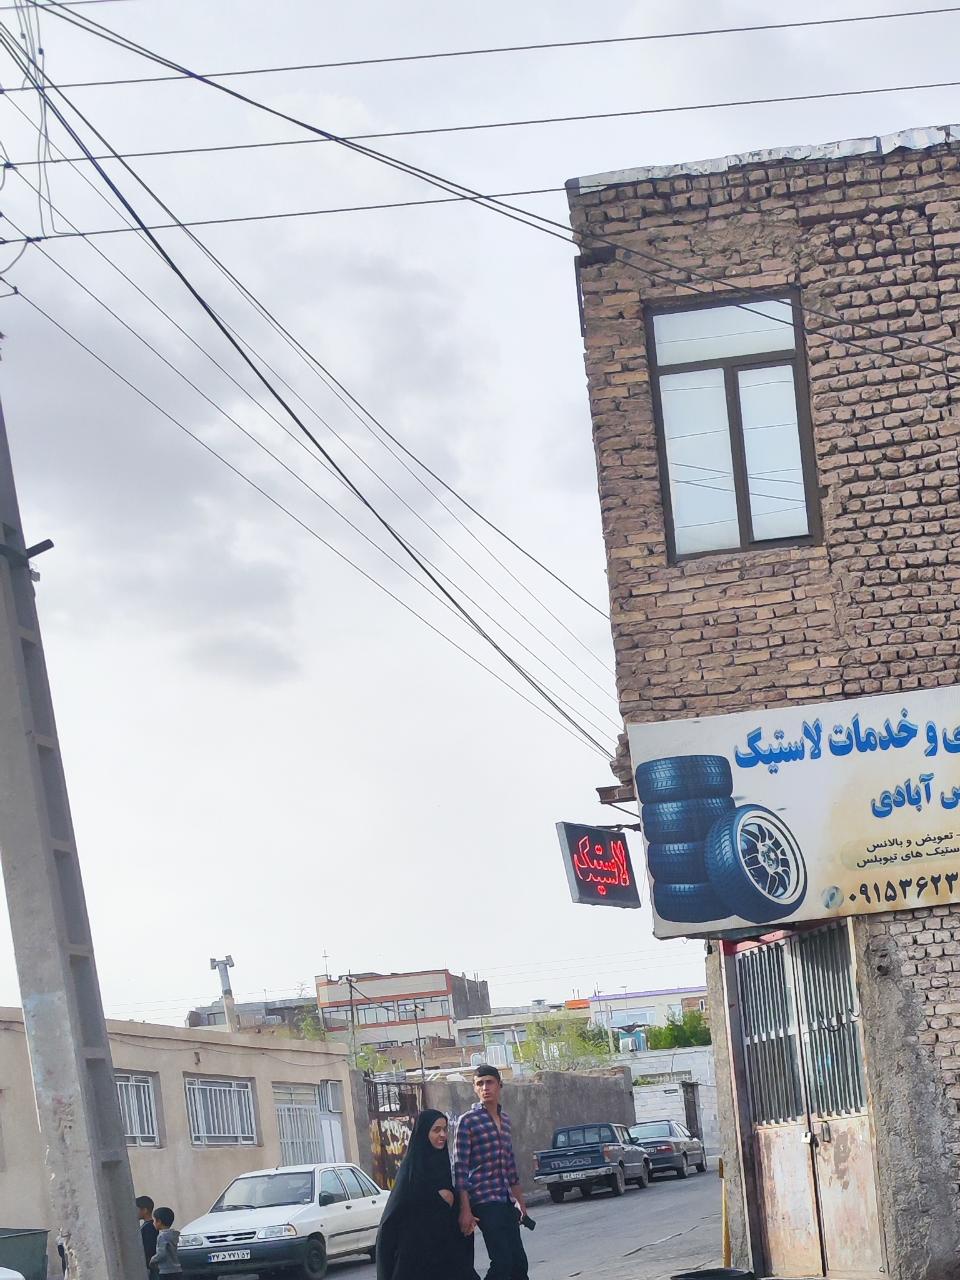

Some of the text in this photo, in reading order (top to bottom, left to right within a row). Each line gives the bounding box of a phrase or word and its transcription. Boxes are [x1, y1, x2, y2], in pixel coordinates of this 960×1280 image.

[734, 717, 824, 775] لاستیک
[828, 707, 919, 757] خدمات
[923, 719, 939, 758] و
[870, 772, 935, 819] آبادی
[866, 837, 904, 854] بالانس
[905, 838, 913, 848] و
[914, 831, 955, 847] تعویض
[900, 849, 924, 863] های
